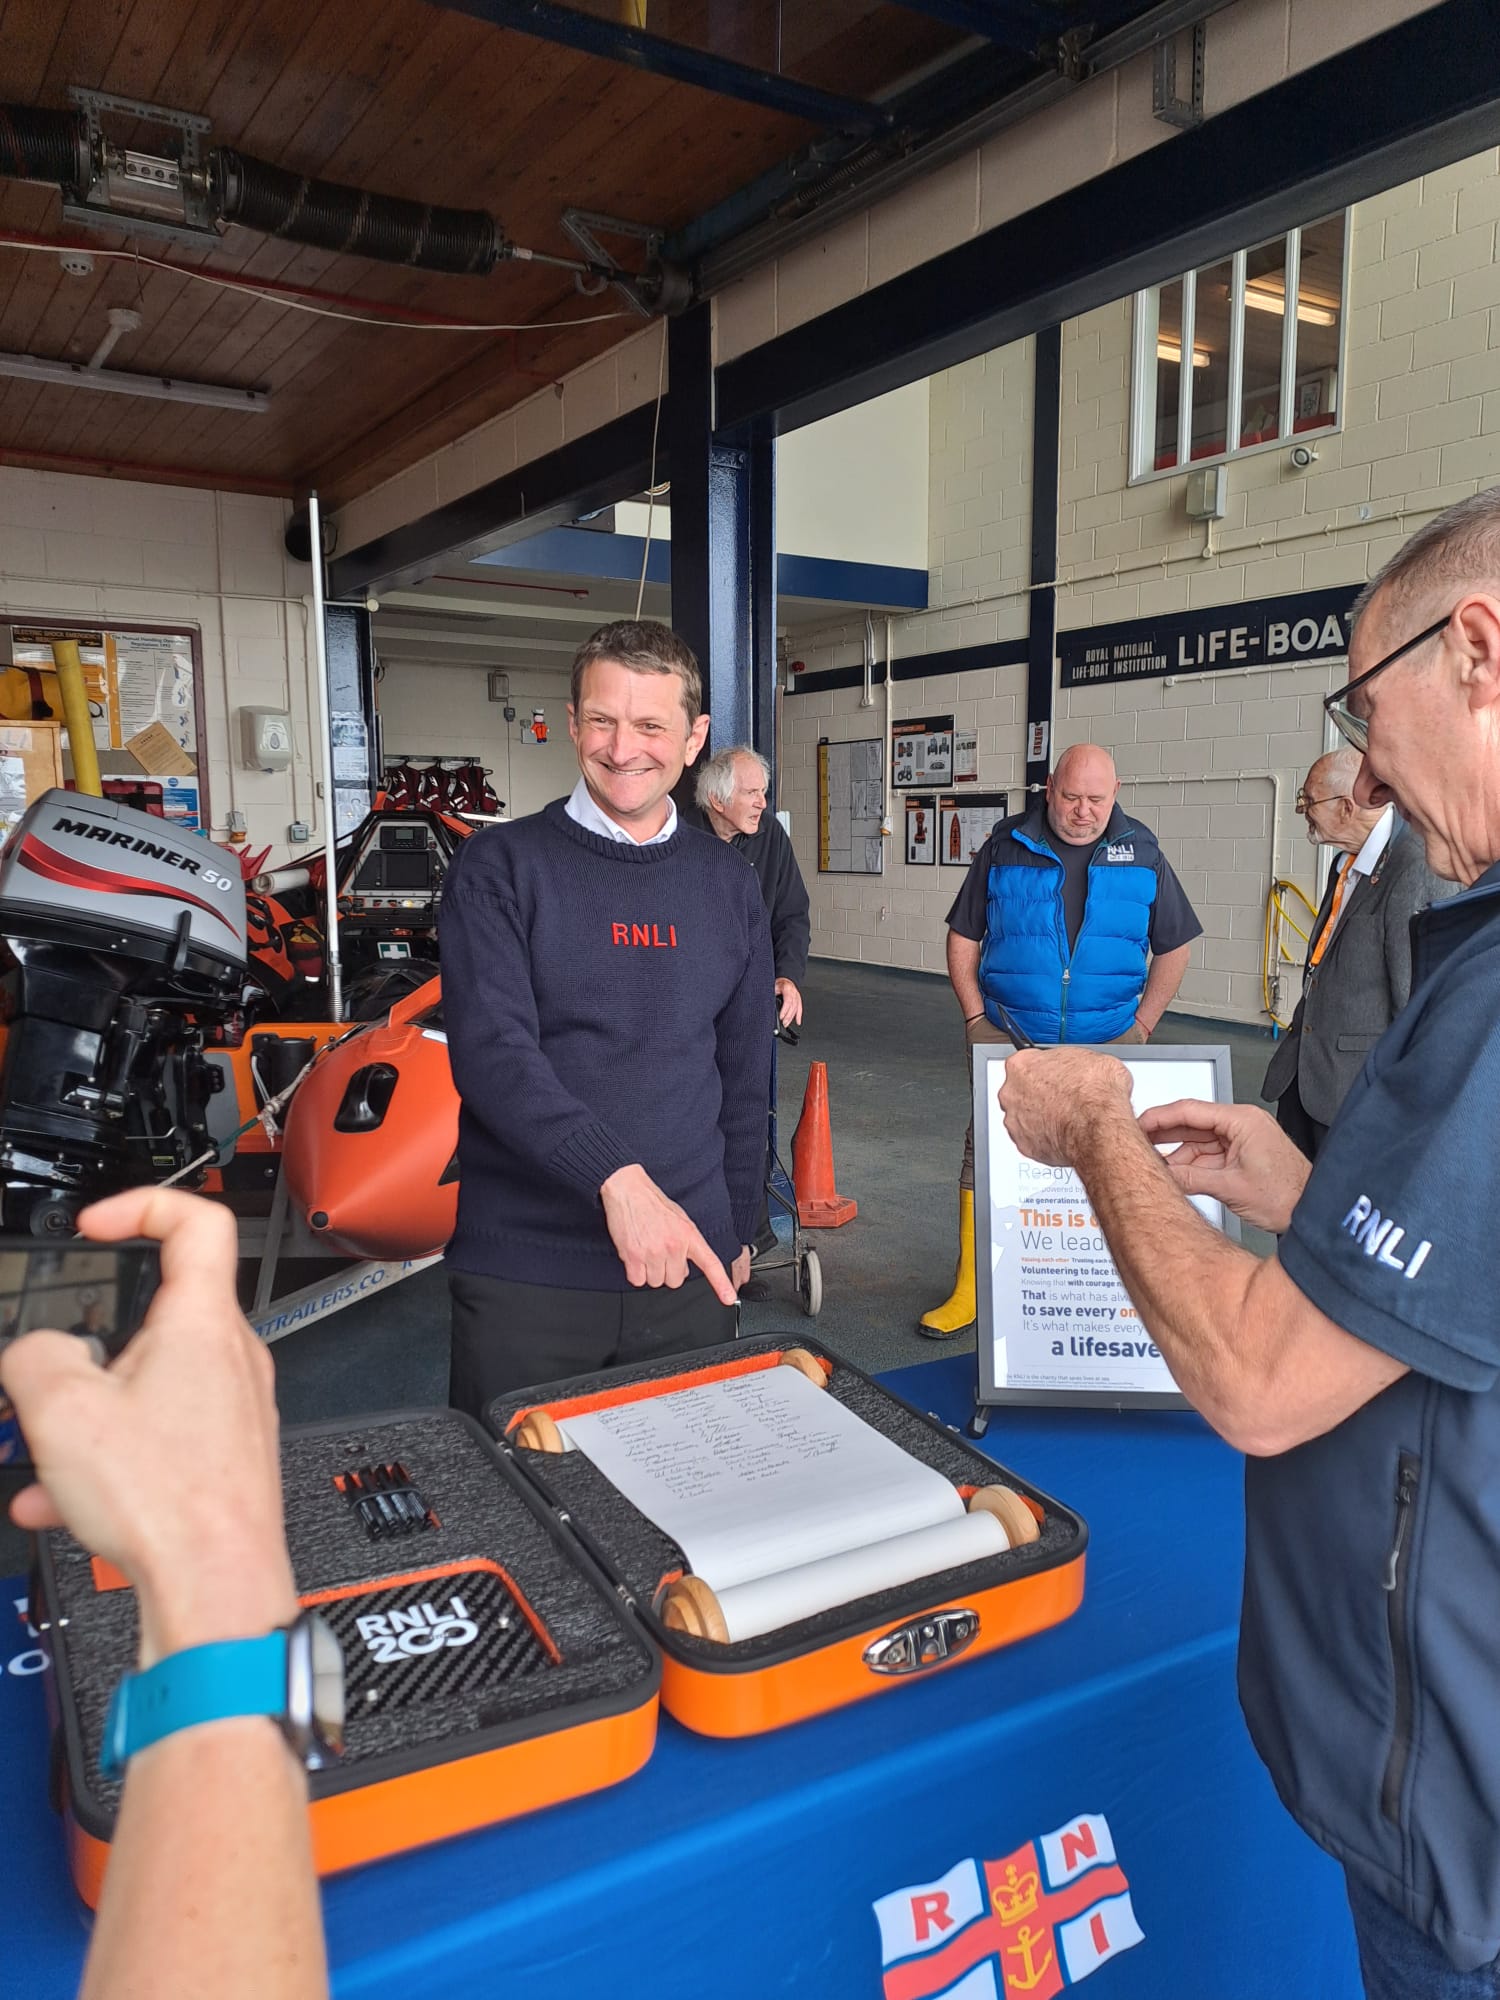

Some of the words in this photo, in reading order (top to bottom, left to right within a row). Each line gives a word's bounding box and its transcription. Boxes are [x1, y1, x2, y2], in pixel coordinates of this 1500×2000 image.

[1086, 649, 1109, 663] ROYAL
[1113, 641, 1153, 660] NATIONAL
[1072, 665, 1109, 680] LIFE-BOAT
[1113, 655, 1167, 675] INSTITUTION
[52, 818, 201, 876] MARINER
[201, 869, 232, 891] 50
[1107, 844, 1134, 855] RNLI
[611, 922, 677, 947] RNLI
[1018, 1162, 1073, 1184] Ready
[1019, 1196, 1034, 1204] Like
[1036, 1197, 1079, 1205] generations
[1018, 1208, 1063, 1227] This
[1067, 1209, 1085, 1227] is
[1020, 1230, 1053, 1250] We
[1060, 1231, 1104, 1251] lead
[1342, 1194, 1432, 1279] RNLI
[1021, 1265, 1079, 1276] Volunteering
[1080, 1267, 1089, 1275] to
[1091, 1267, 1110, 1275] face
[1021, 1279, 1051, 1287] Knowing
[1021, 1290, 1047, 1300] That
[1049, 1291, 1058, 1300] is
[1060, 1291, 1086, 1301] what
[1089, 1291, 1108, 1301] has
[1111, 1292, 1131, 1302] alw
[1022, 1304, 1036, 1316] to
[1039, 1306, 1072, 1317] save
[1075, 1307, 1117, 1320] every
[1023, 1320, 1040, 1331] It's
[1042, 1321, 1070, 1331] what
[1072, 1321, 1111, 1333] makes
[1113, 1323, 1144, 1337] every
[1051, 1340, 1064, 1356] a
[1070, 1336, 1161, 1358] lifesave
[356, 1596, 469, 1640] RNLI
[366, 1619, 479, 1663] 200
[910, 1890, 955, 1943] R
[1061, 1822, 1098, 1872] N
[1089, 1913, 1111, 1955] I
